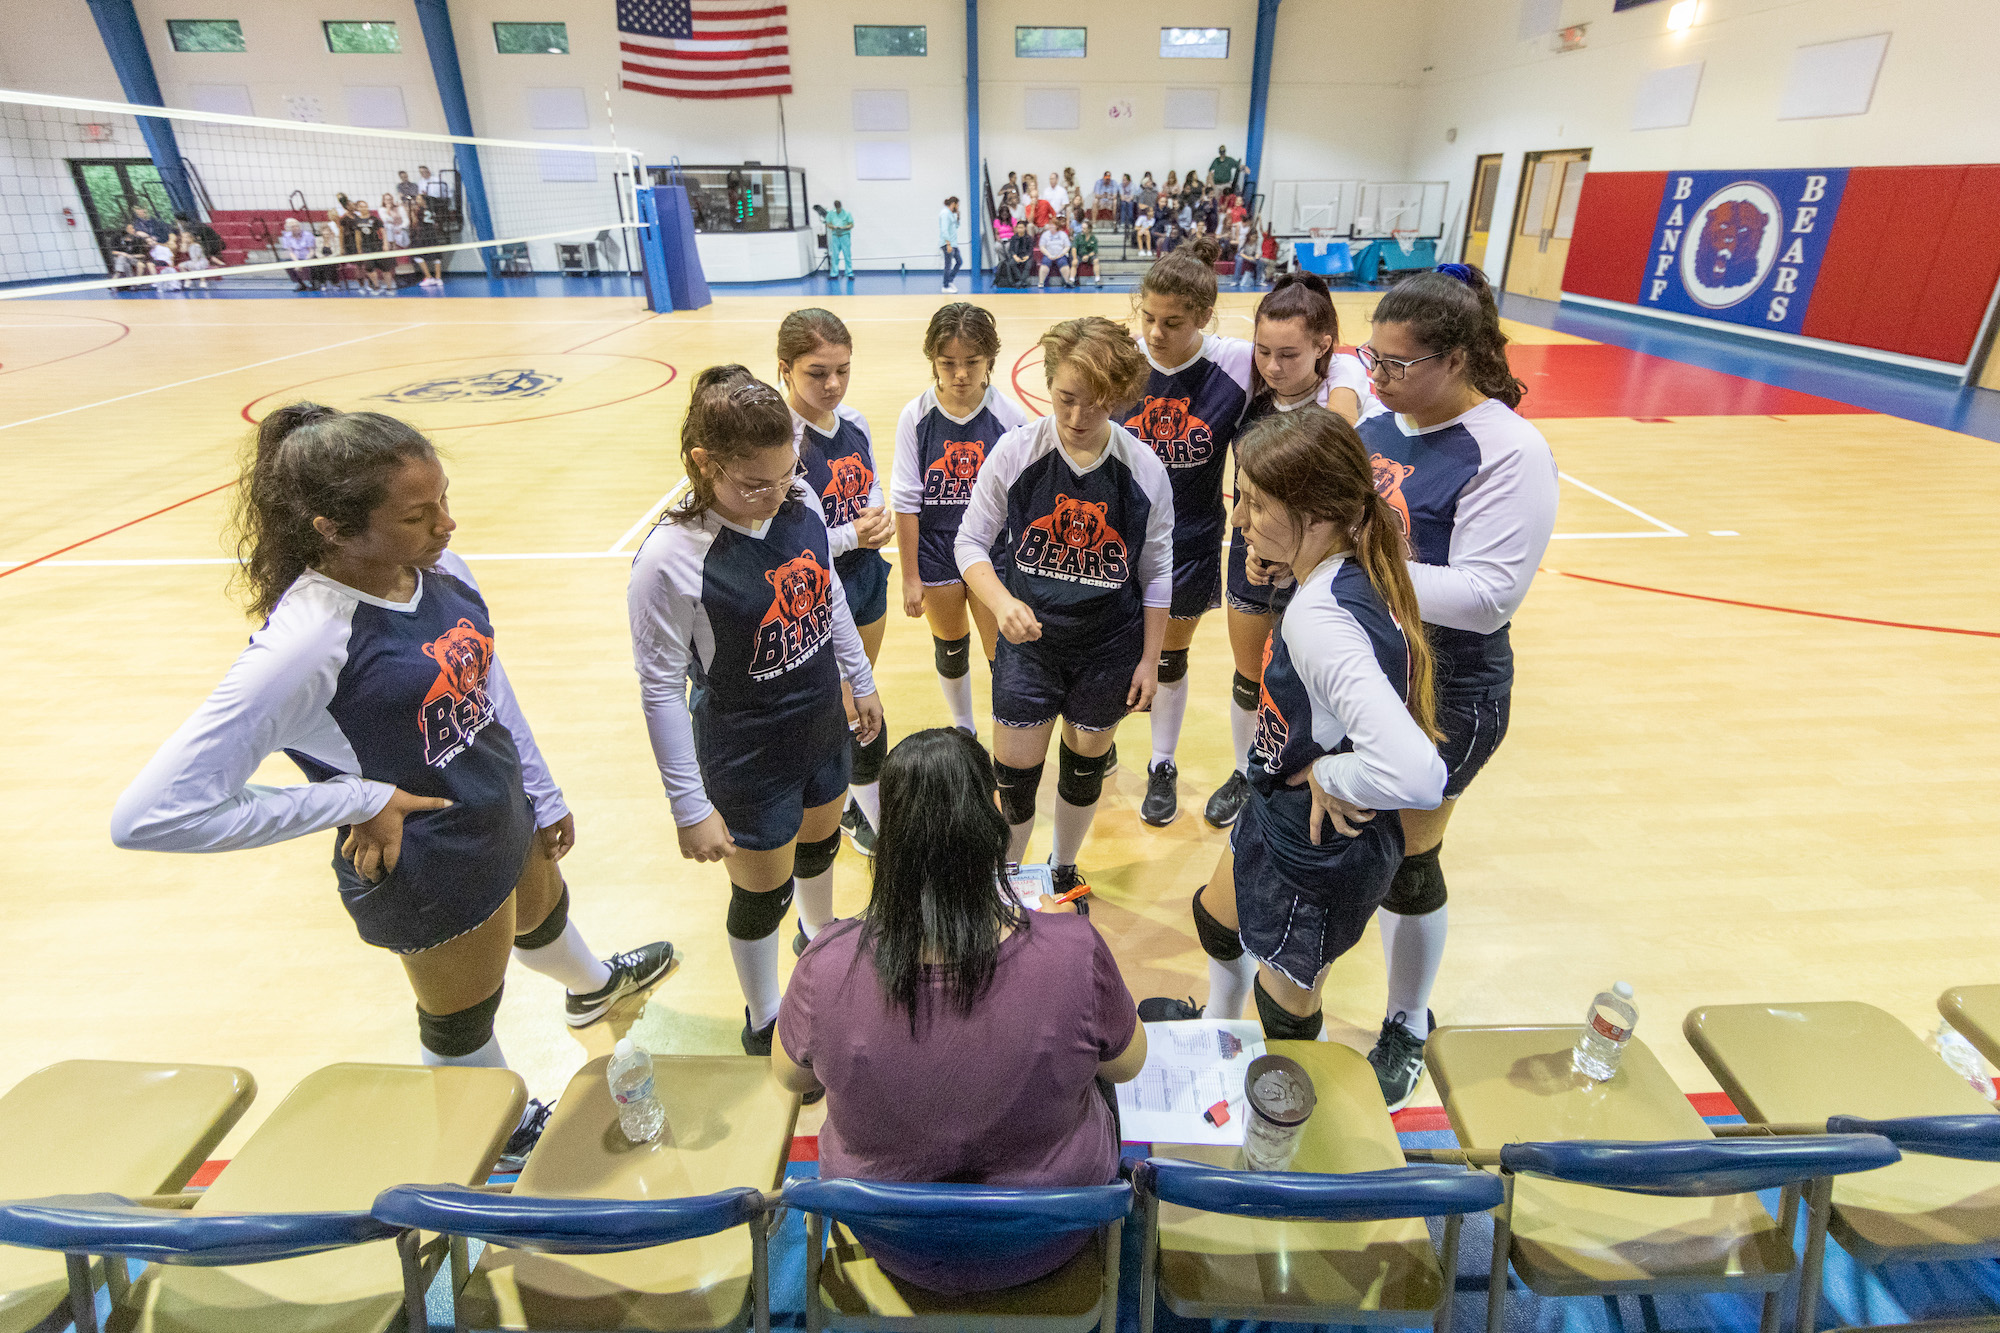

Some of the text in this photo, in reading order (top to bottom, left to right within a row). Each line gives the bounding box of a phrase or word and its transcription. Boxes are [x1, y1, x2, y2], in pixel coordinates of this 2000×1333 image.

[1649, 177, 1694, 301] BANFF
[1766, 175, 1828, 322] BEARS
[1124, 426, 1213, 463] ARS
[924, 468, 978, 500] BEA
[820, 482, 873, 528] BEAR
[1015, 525, 1129, 582] BEARS
[1016, 561, 1036, 575] THE
[1038, 568, 1078, 583] BANFF
[753, 643, 819, 682] THE BANFF
[435, 744, 466, 769] THE
